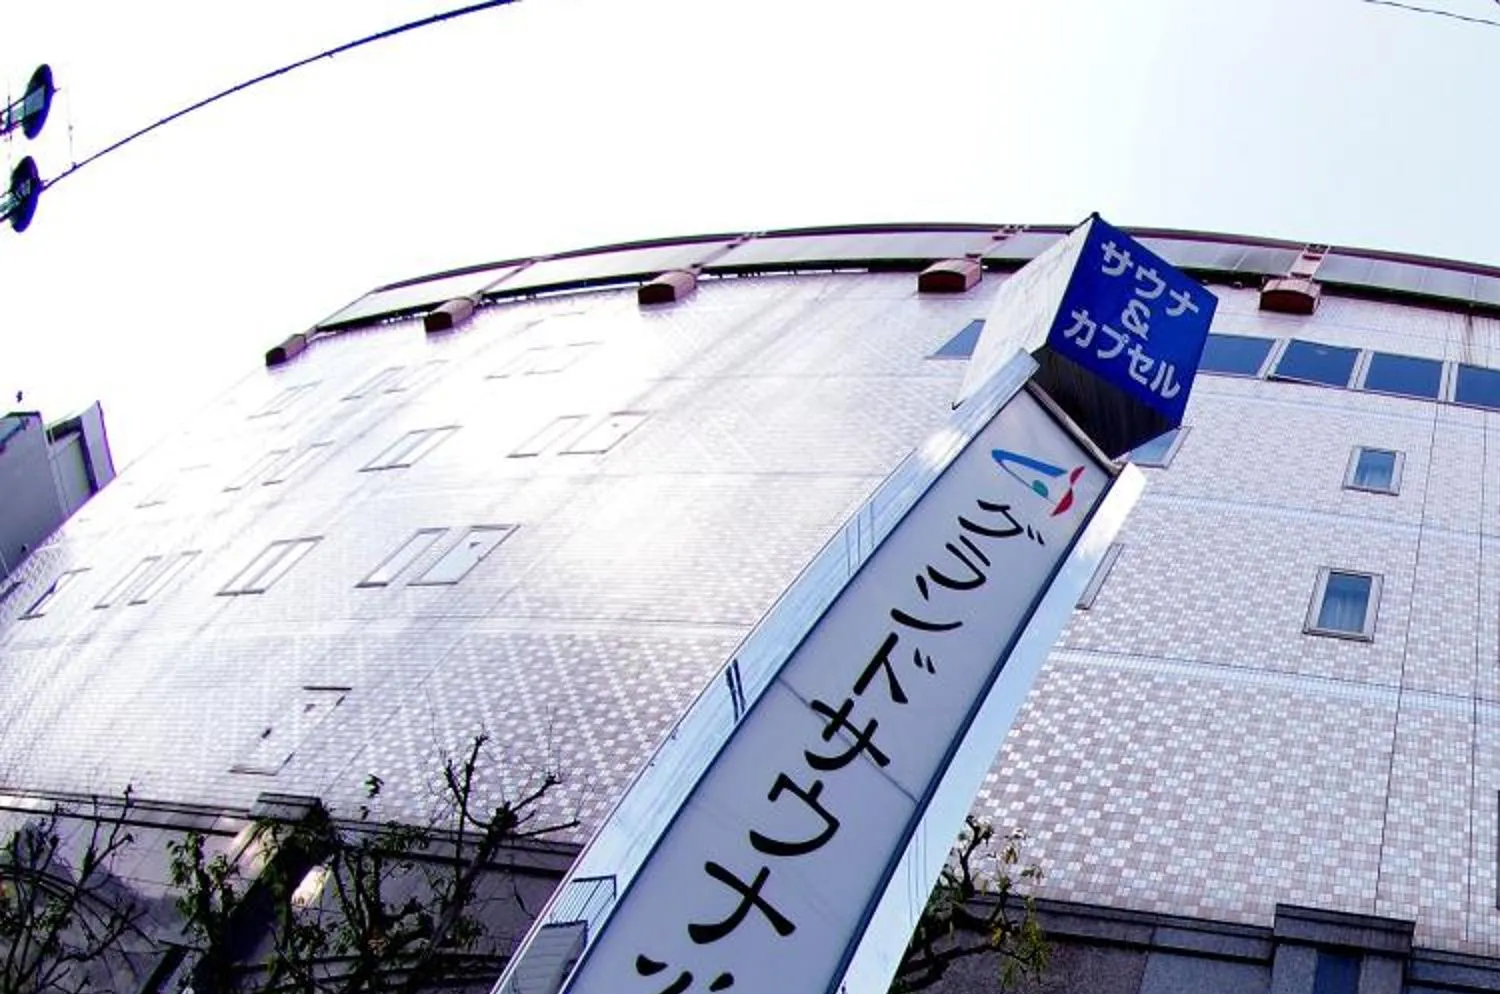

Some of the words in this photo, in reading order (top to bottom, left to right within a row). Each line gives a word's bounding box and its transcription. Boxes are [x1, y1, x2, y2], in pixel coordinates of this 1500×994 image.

[1101, 241, 1199, 317] サウナ
[1063, 308, 1181, 399] カプセル
[1121, 299, 1151, 341] &
